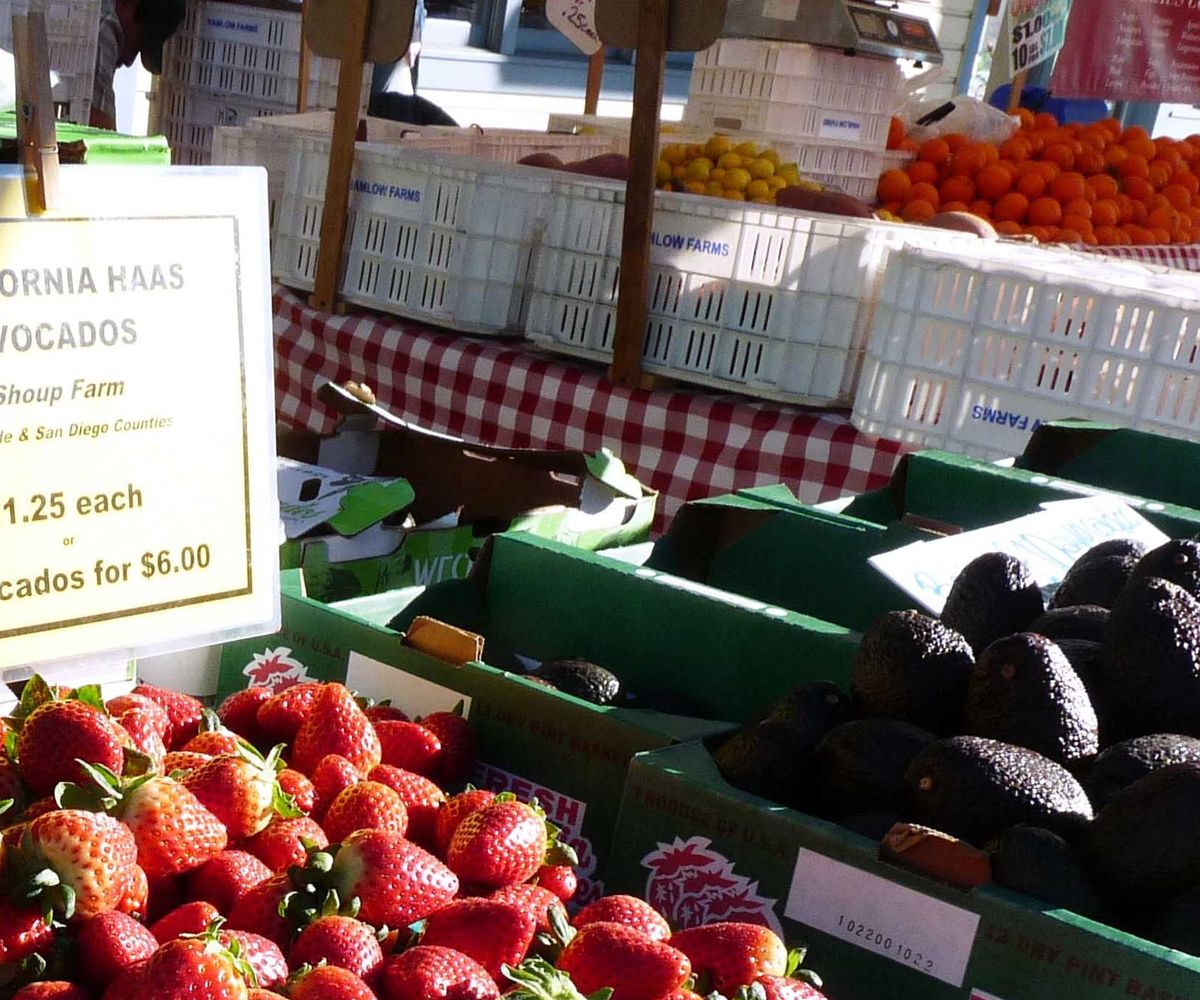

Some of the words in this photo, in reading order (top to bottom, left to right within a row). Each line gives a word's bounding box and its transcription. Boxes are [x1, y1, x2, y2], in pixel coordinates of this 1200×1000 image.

[388, 185, 421, 202] FARMS
[686, 238, 730, 257] FARMS
[108, 263, 185, 293] HAAS
[71, 379, 125, 401] Farm
[18, 428, 29, 442] &
[35, 425, 64, 440] San
[68, 423, 109, 440] Diego
[114, 415, 174, 432] Counties
[971, 405, 1029, 431] FARMS
[76, 483, 143, 515] each
[63, 536, 75, 547] or
[94, 560, 132, 587] for
[141, 543, 211, 580] $6.00
[1066, 954, 1120, 987] PINT
